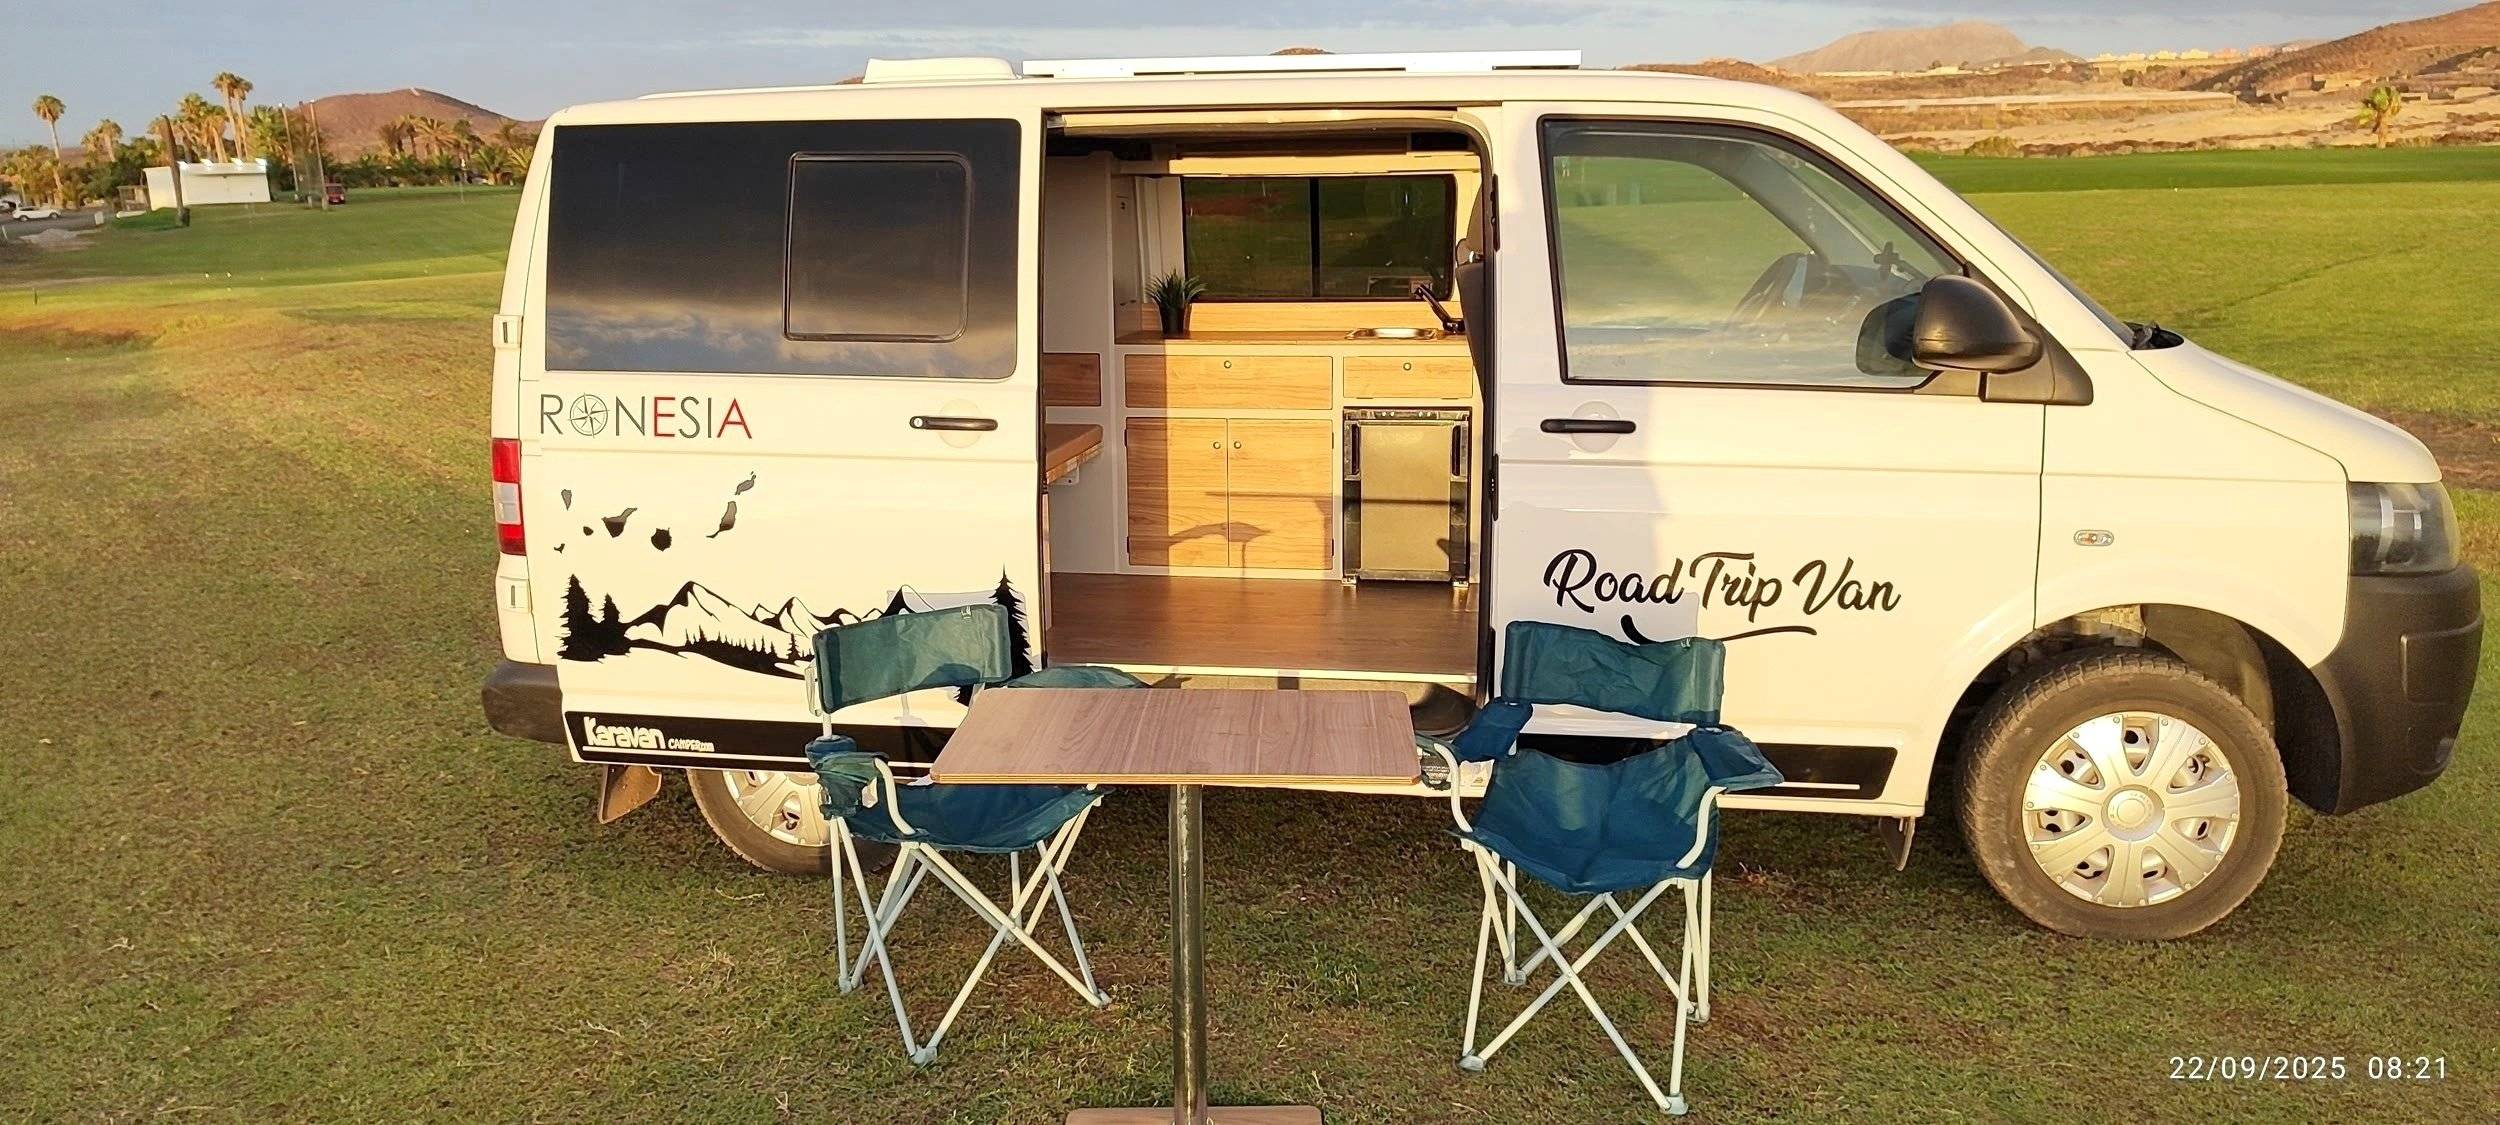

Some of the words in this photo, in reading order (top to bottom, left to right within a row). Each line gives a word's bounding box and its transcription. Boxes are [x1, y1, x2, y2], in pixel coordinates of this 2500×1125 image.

[540, 393, 753, 439] RONESIA
[1543, 549, 1684, 613] Road
[1689, 551, 1783, 623] Trip
[1792, 557, 1902, 615] Van
[583, 716, 666, 749] Karavan
